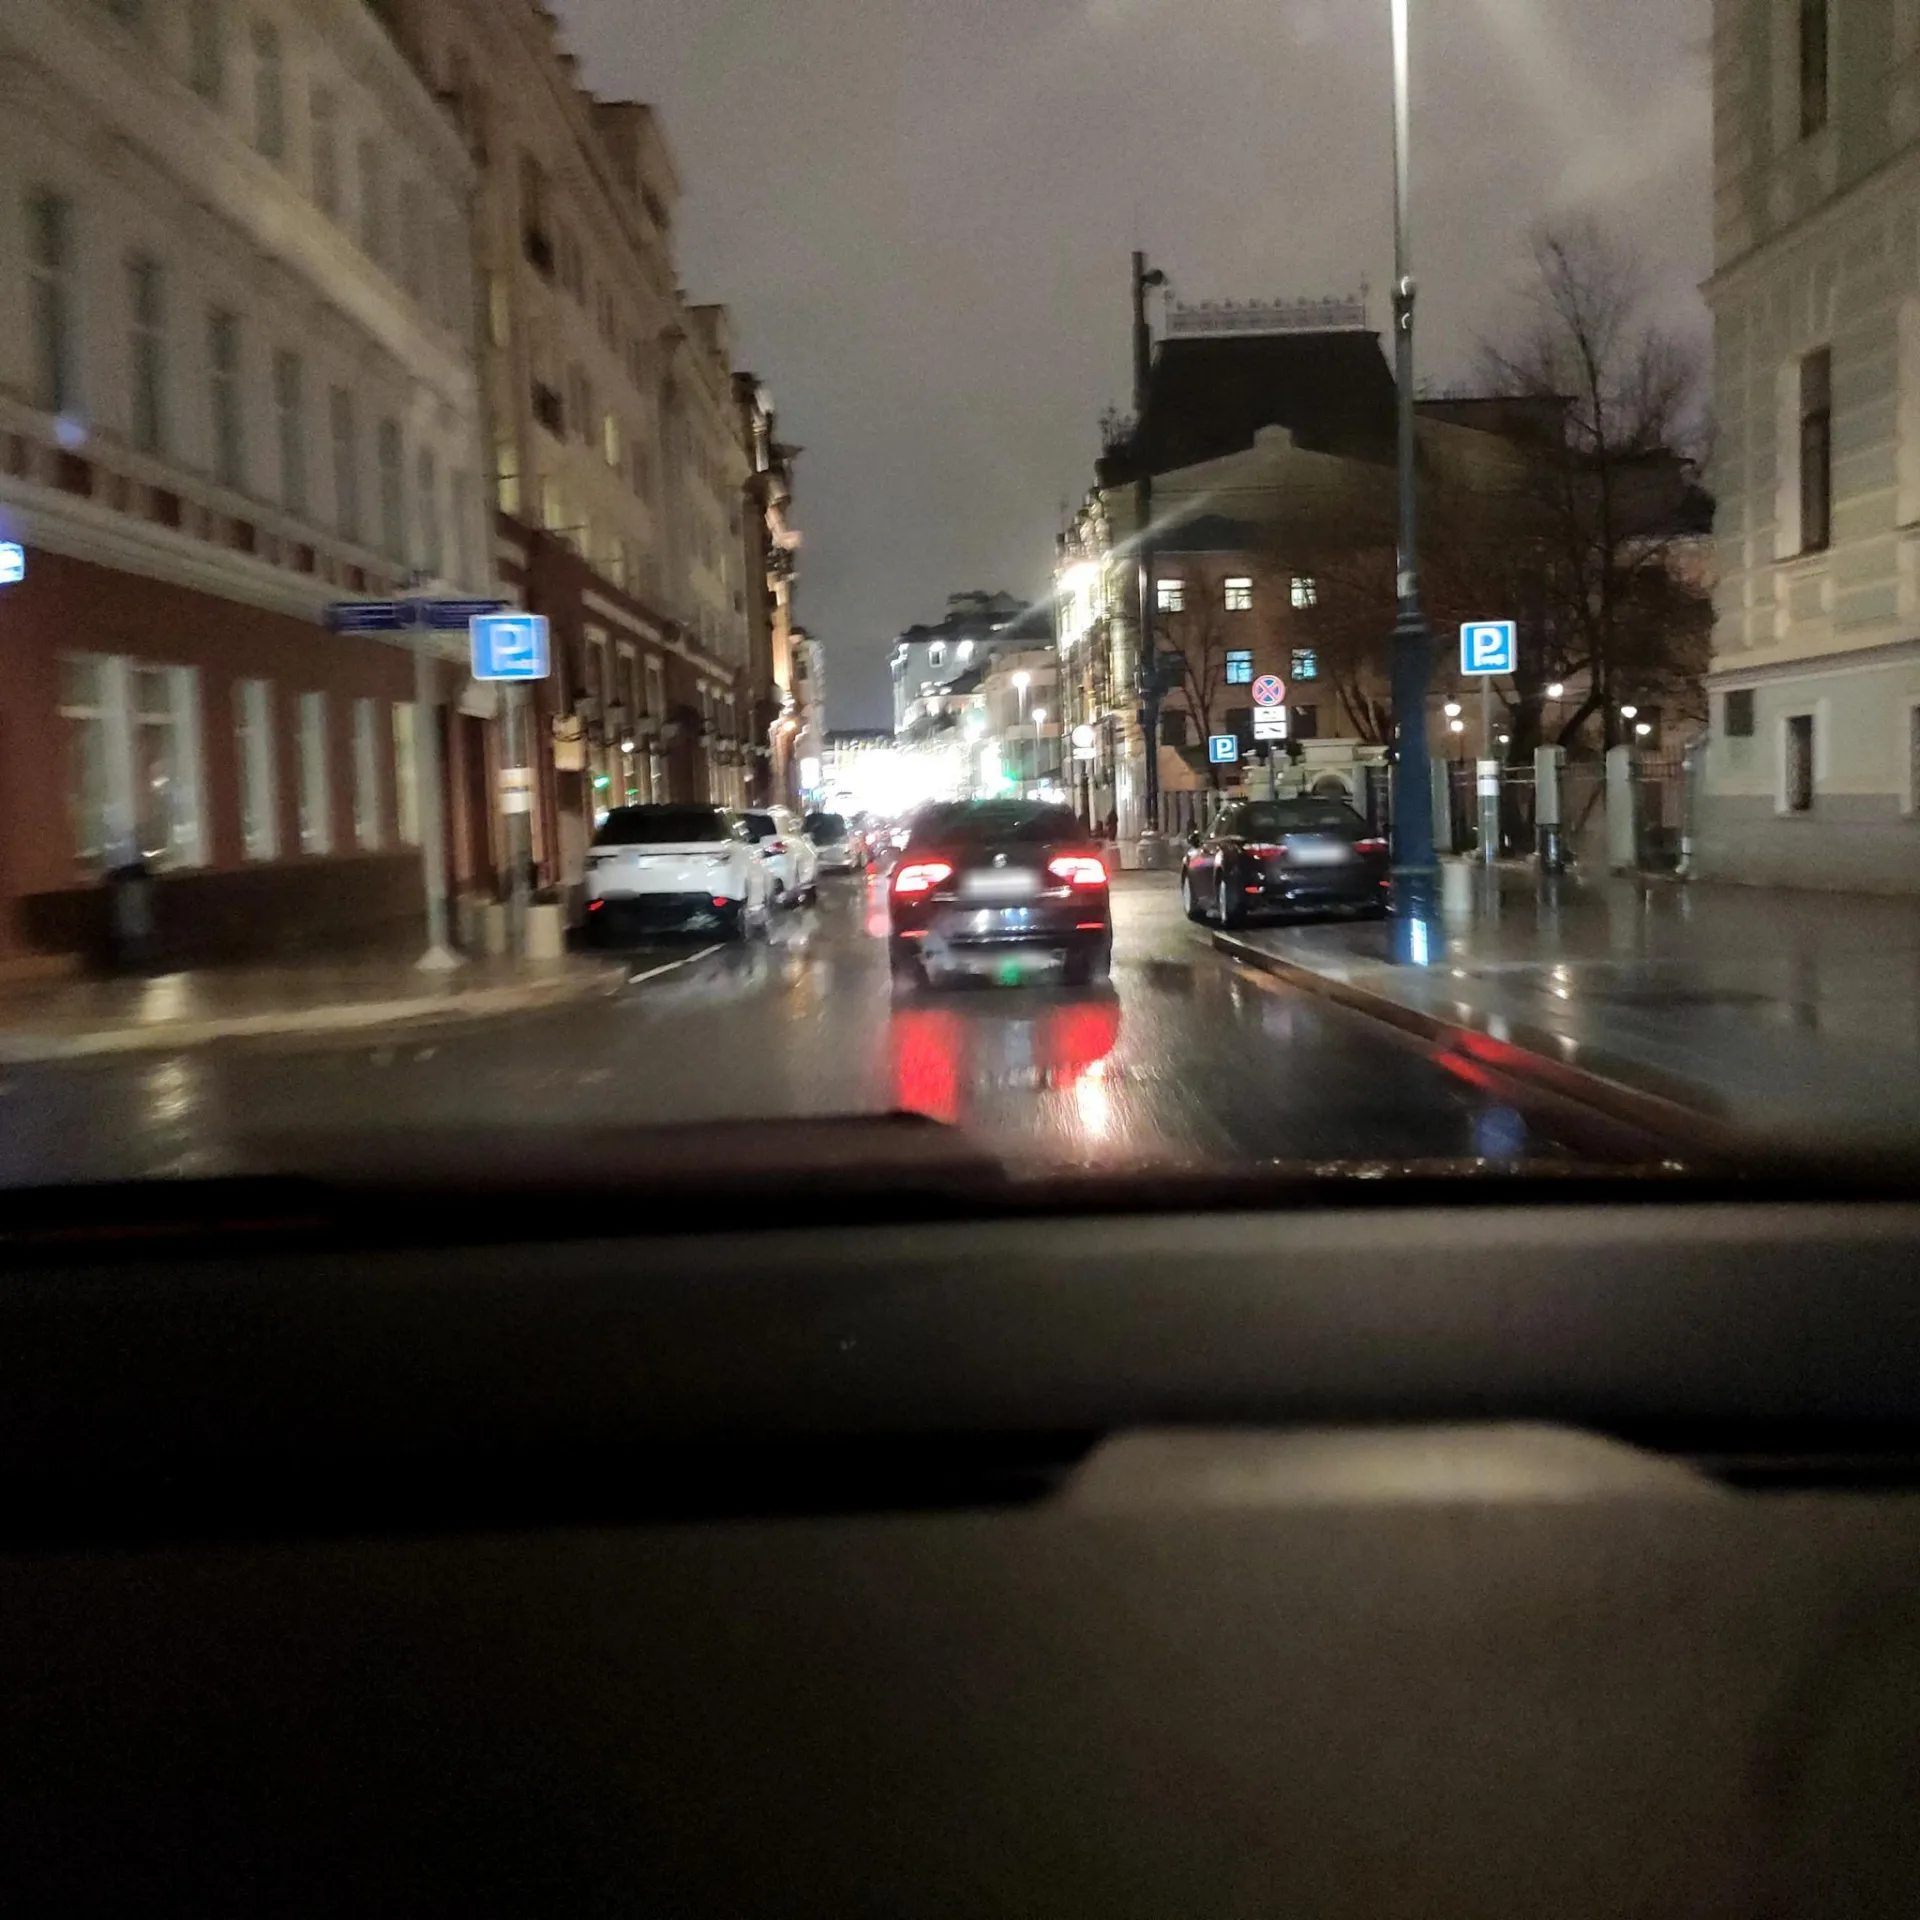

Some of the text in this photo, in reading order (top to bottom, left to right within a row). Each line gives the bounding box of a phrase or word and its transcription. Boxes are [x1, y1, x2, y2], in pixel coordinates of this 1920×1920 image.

[490, 624, 531, 671] P
[1473, 628, 1503, 666] P
[1217, 739, 1233, 759] P
